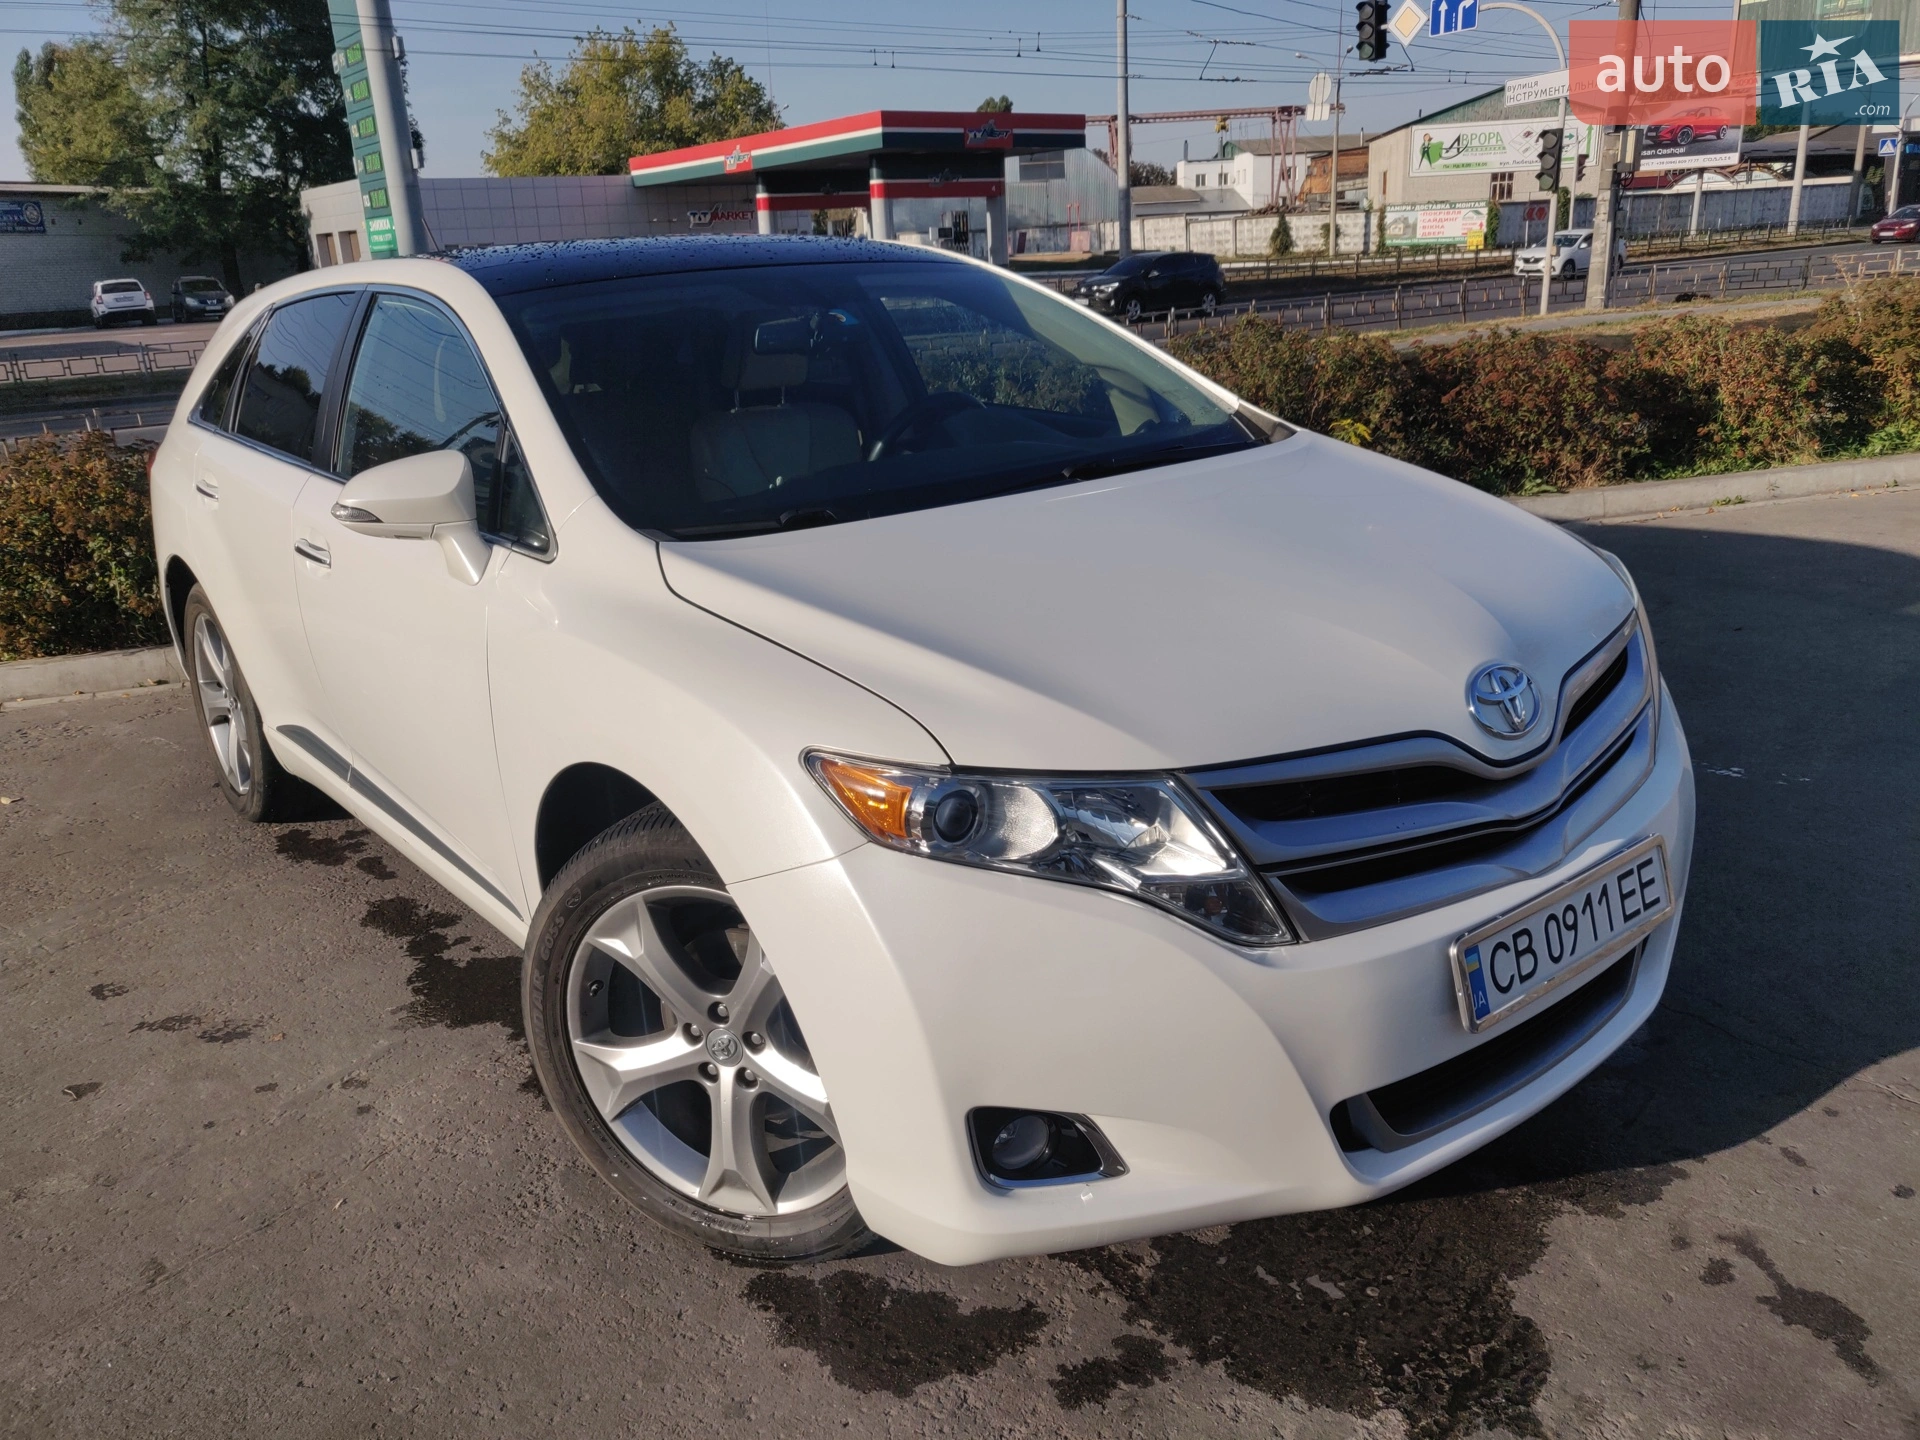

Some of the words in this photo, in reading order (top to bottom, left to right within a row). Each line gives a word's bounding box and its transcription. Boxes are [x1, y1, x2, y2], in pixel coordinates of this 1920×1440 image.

[1506, 80, 1599, 104] ІНСТРУМЕНТАЛЬН
[1507, 80, 1539, 93] вулиця
[1445, 131, 1504, 153] АВРОРА
[1657, 146, 1686, 156] Qashqai
[1415, 203, 1451, 211] ДОСТАВКА
[1544, 882, 1614, 964] 0911
